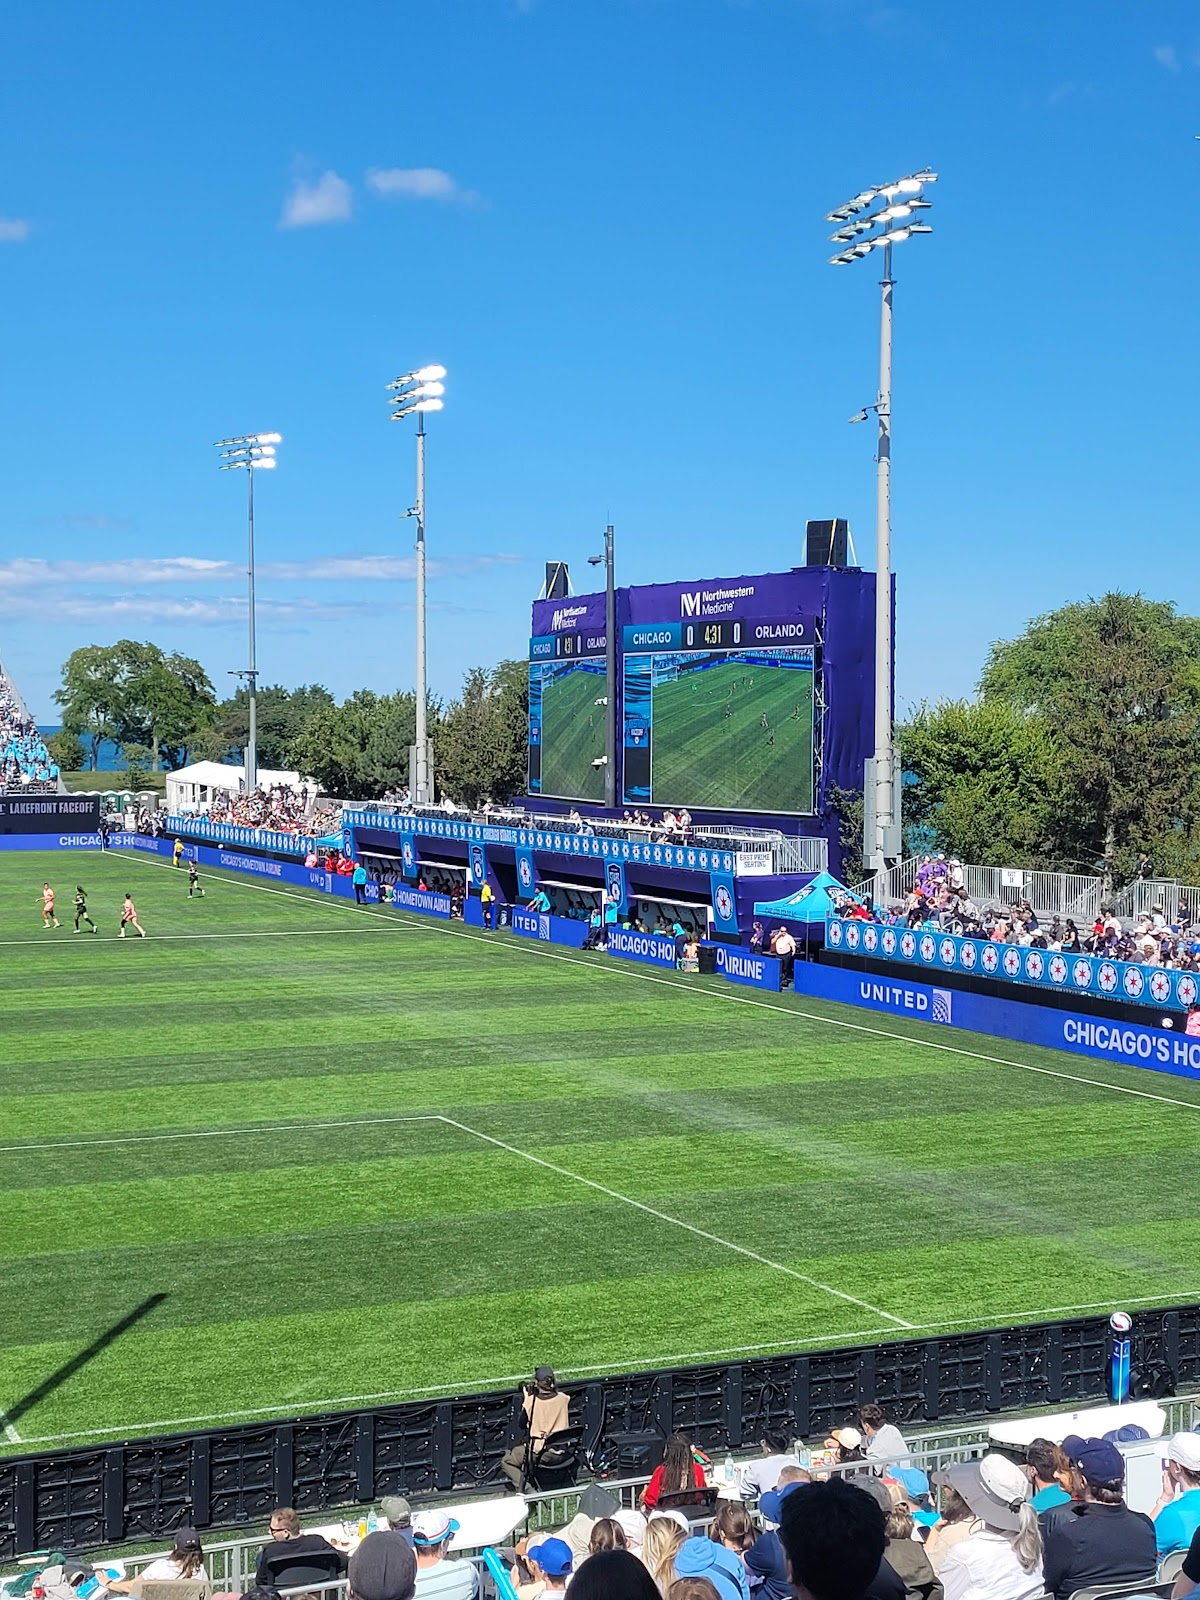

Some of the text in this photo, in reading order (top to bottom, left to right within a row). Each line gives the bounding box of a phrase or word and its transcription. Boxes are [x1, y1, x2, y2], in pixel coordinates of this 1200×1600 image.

[702, 586, 754, 602] Northwestern
[632, 622, 804, 646] CHICAGO 0 4:31 0 ORLANDO
[533, 643, 551, 655] CHICAGO
[586, 636, 607, 649] ORLAND
[9, 802, 57, 814] LAKEFRONT
[58, 802, 94, 814] FACEOFF
[739, 853, 770, 862] EAST PRIME
[744, 860, 767, 868] SEATING
[397, 890, 433, 910] HOMETOWN
[860, 981, 929, 1012] UNITED
[1064, 1019, 1200, 1069] CHICAGO'S HO
